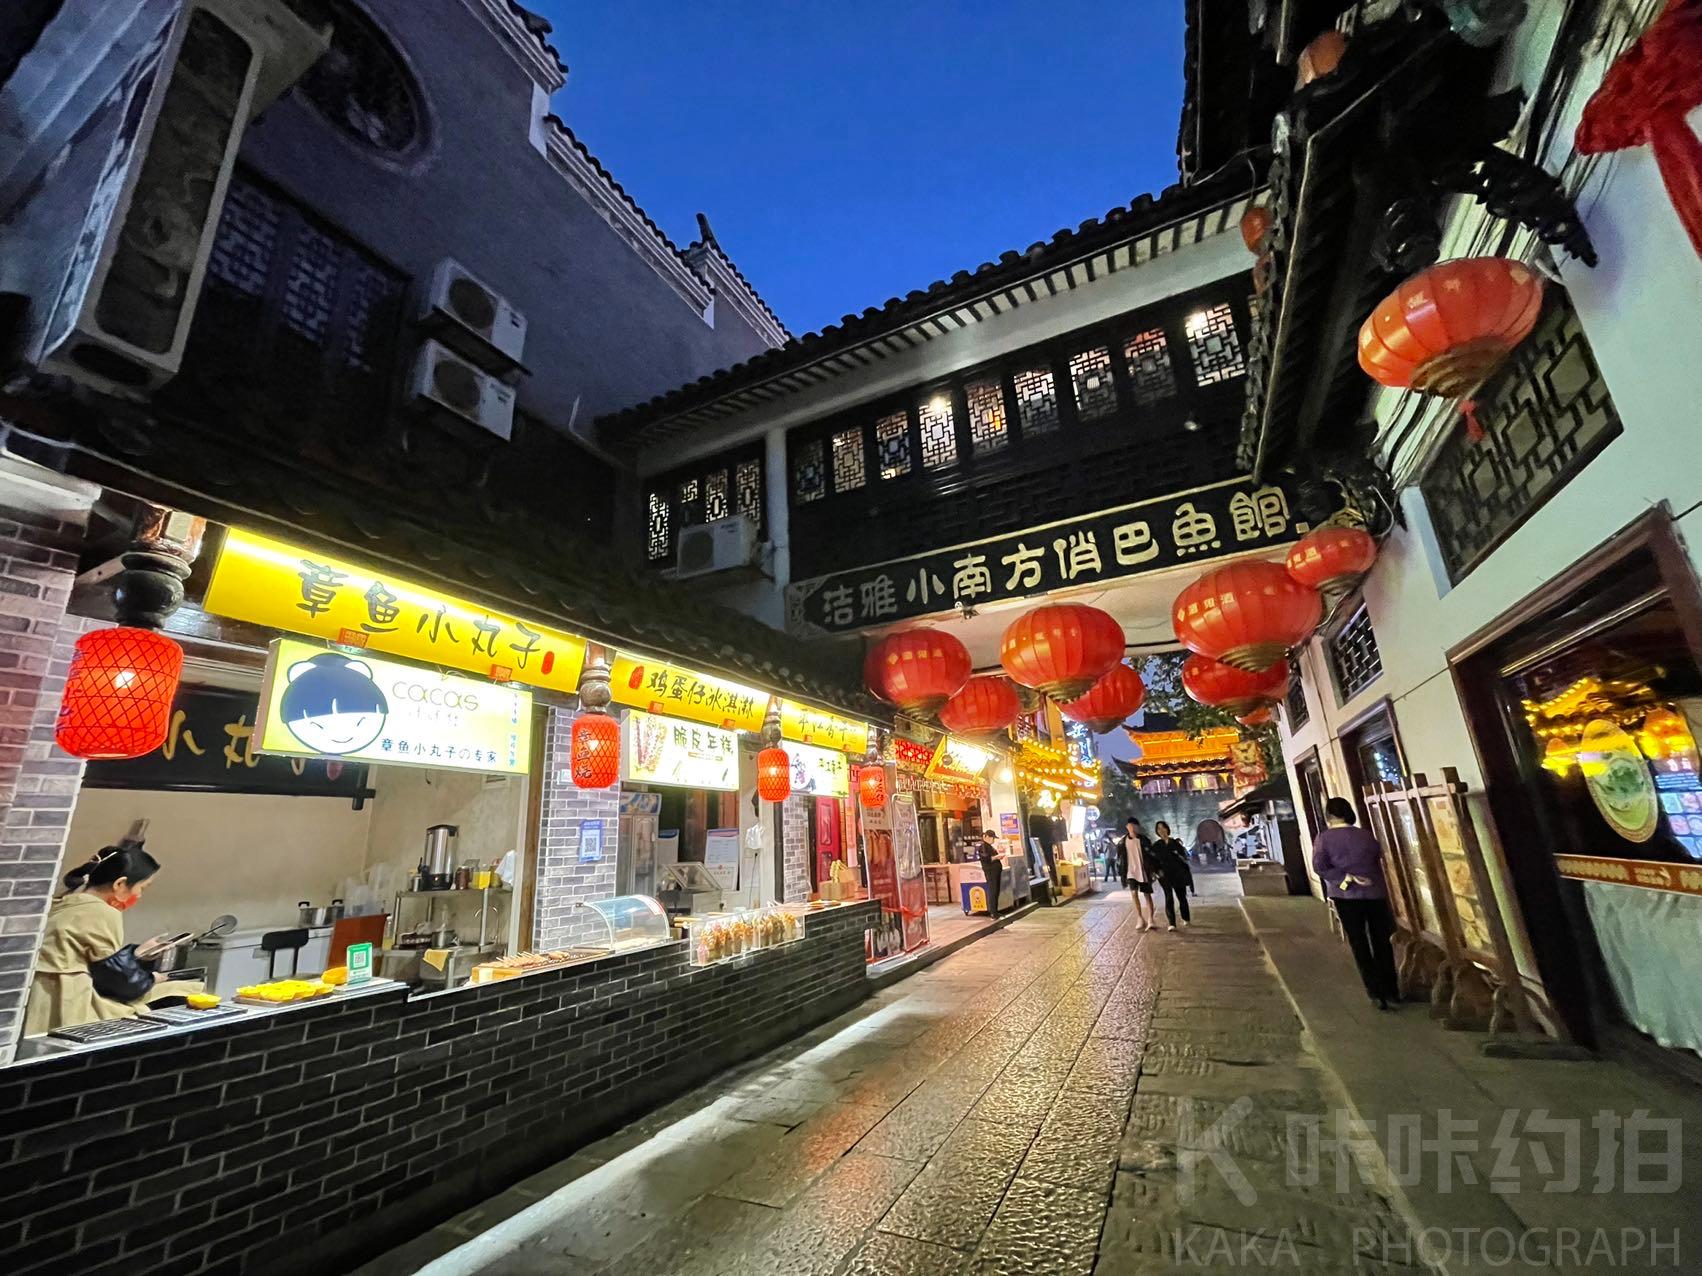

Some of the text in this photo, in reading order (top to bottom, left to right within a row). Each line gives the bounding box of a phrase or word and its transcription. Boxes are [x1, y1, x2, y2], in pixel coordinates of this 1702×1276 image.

[296, 559, 541, 669] 章鱼小丸子
[392, 681, 479, 711] cacas
[646, 669, 754, 718] 鸡蛋仔冰淇淋
[381, 738, 497, 763] 章鱼小丸子の专家
